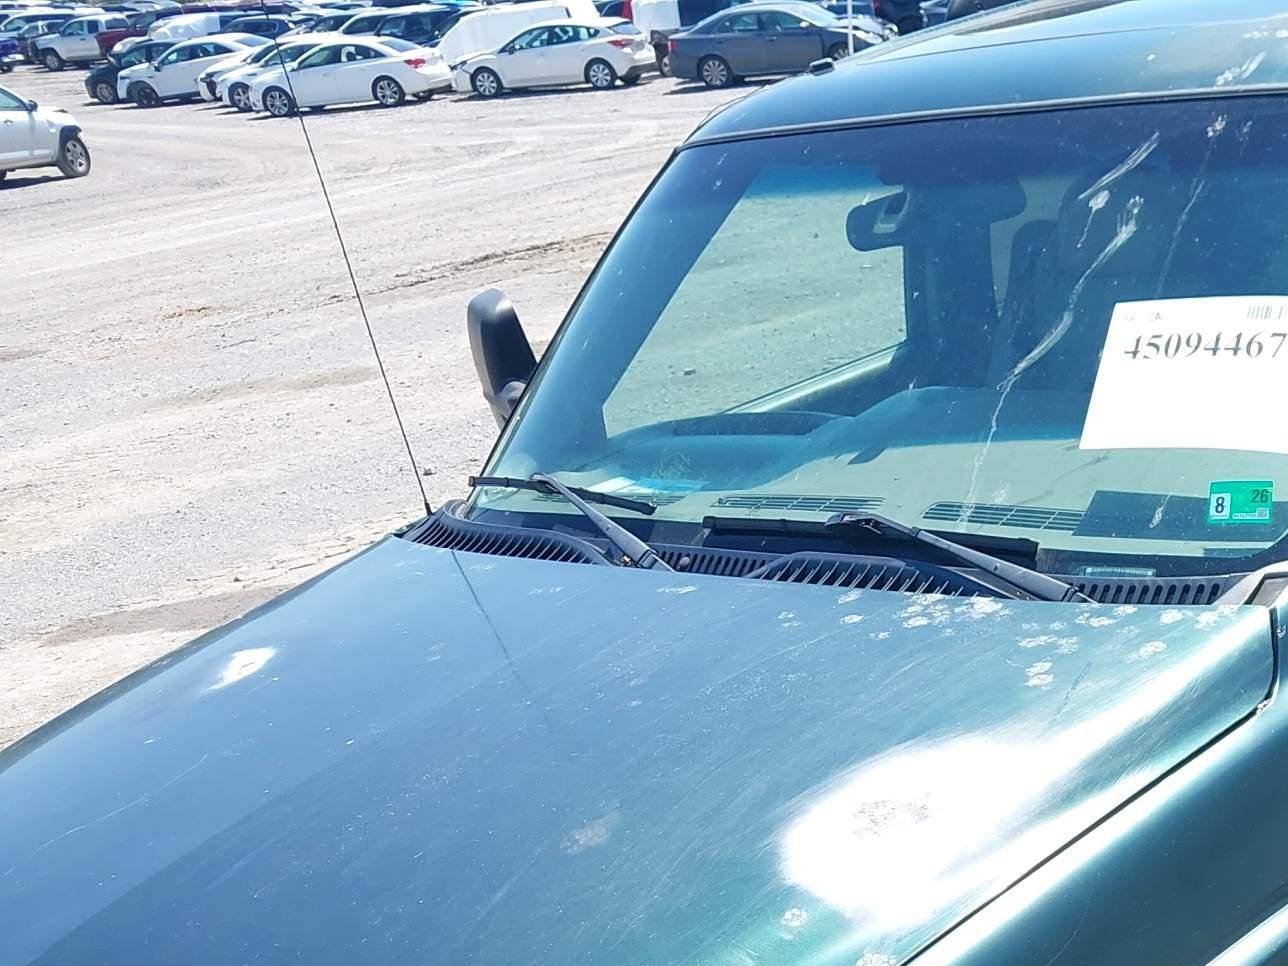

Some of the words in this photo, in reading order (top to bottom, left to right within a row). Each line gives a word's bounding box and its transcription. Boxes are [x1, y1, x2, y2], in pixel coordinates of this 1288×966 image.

[1124, 332, 1288, 359] 45094467
[1215, 496, 1225, 513] 8
[1252, 489, 1268, 503] 26
